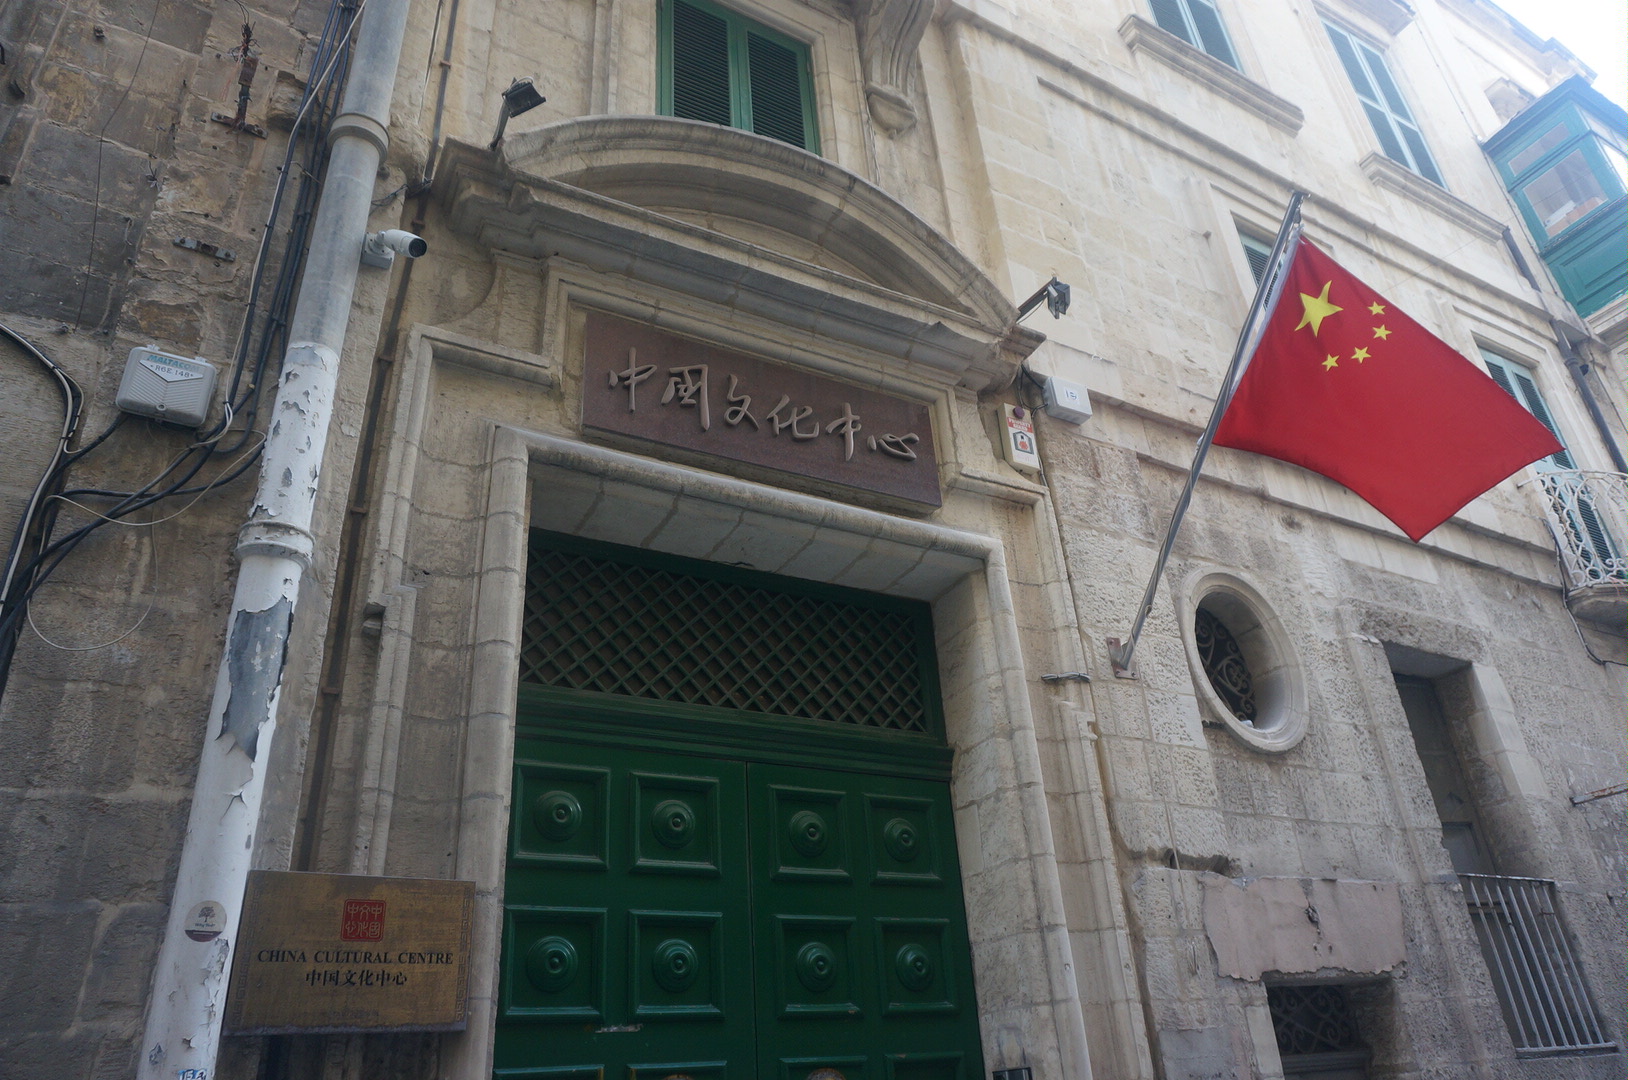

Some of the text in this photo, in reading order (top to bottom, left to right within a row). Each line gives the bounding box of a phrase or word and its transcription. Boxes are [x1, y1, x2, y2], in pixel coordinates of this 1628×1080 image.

[257, 949, 454, 965] CHINA CULTURAL CENTRE
[305, 969, 408, 987] 中国文化中心
